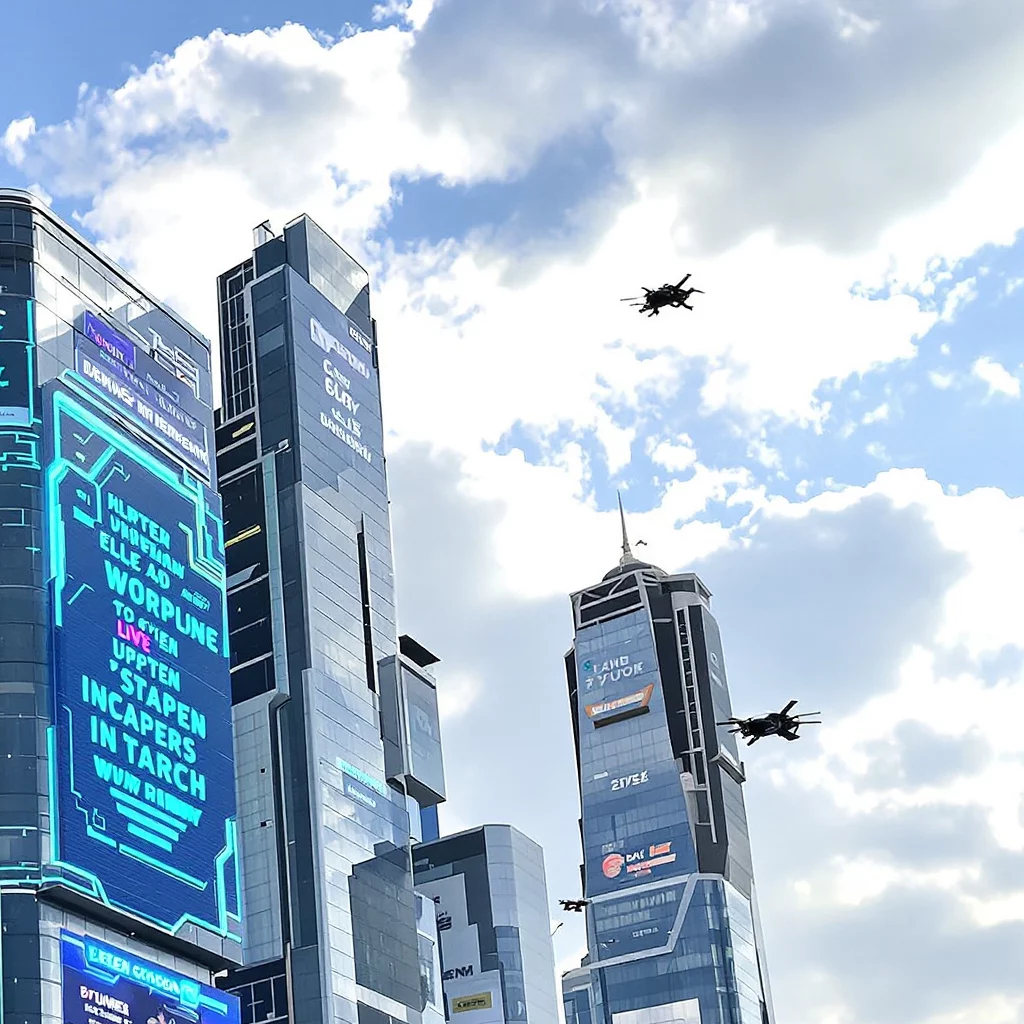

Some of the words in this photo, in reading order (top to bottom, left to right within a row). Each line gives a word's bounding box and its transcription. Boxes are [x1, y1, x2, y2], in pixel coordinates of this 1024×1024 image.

[117, 619, 152, 654] LIVE
[81, 674, 197, 765] INCAPERS
[90, 715, 118, 754] IN
[122, 732, 207, 802] TARCH
